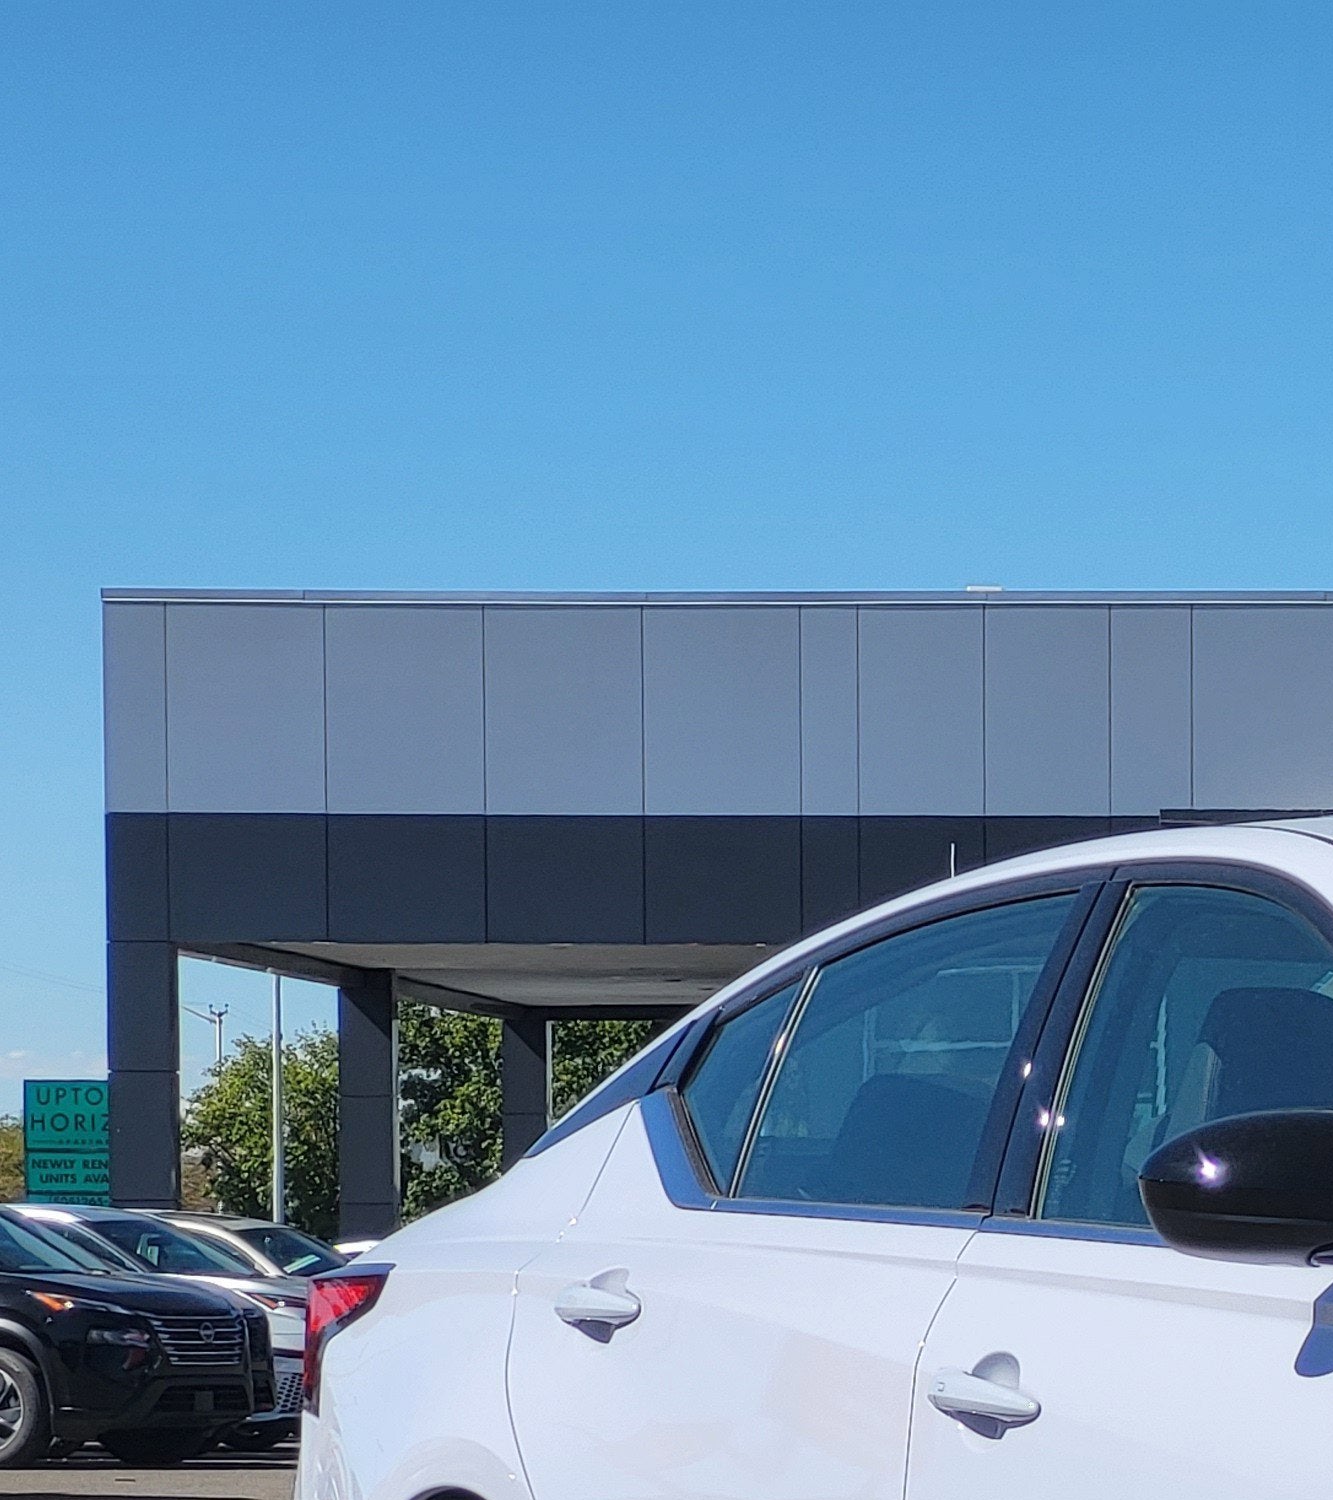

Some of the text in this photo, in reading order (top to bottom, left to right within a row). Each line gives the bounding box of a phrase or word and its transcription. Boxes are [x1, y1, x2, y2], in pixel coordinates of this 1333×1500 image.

[36, 1087, 103, 1105] UPTO
[32, 1158, 108, 1169] NEWLY REN
[40, 1173, 109, 1184] UNITS AVA
